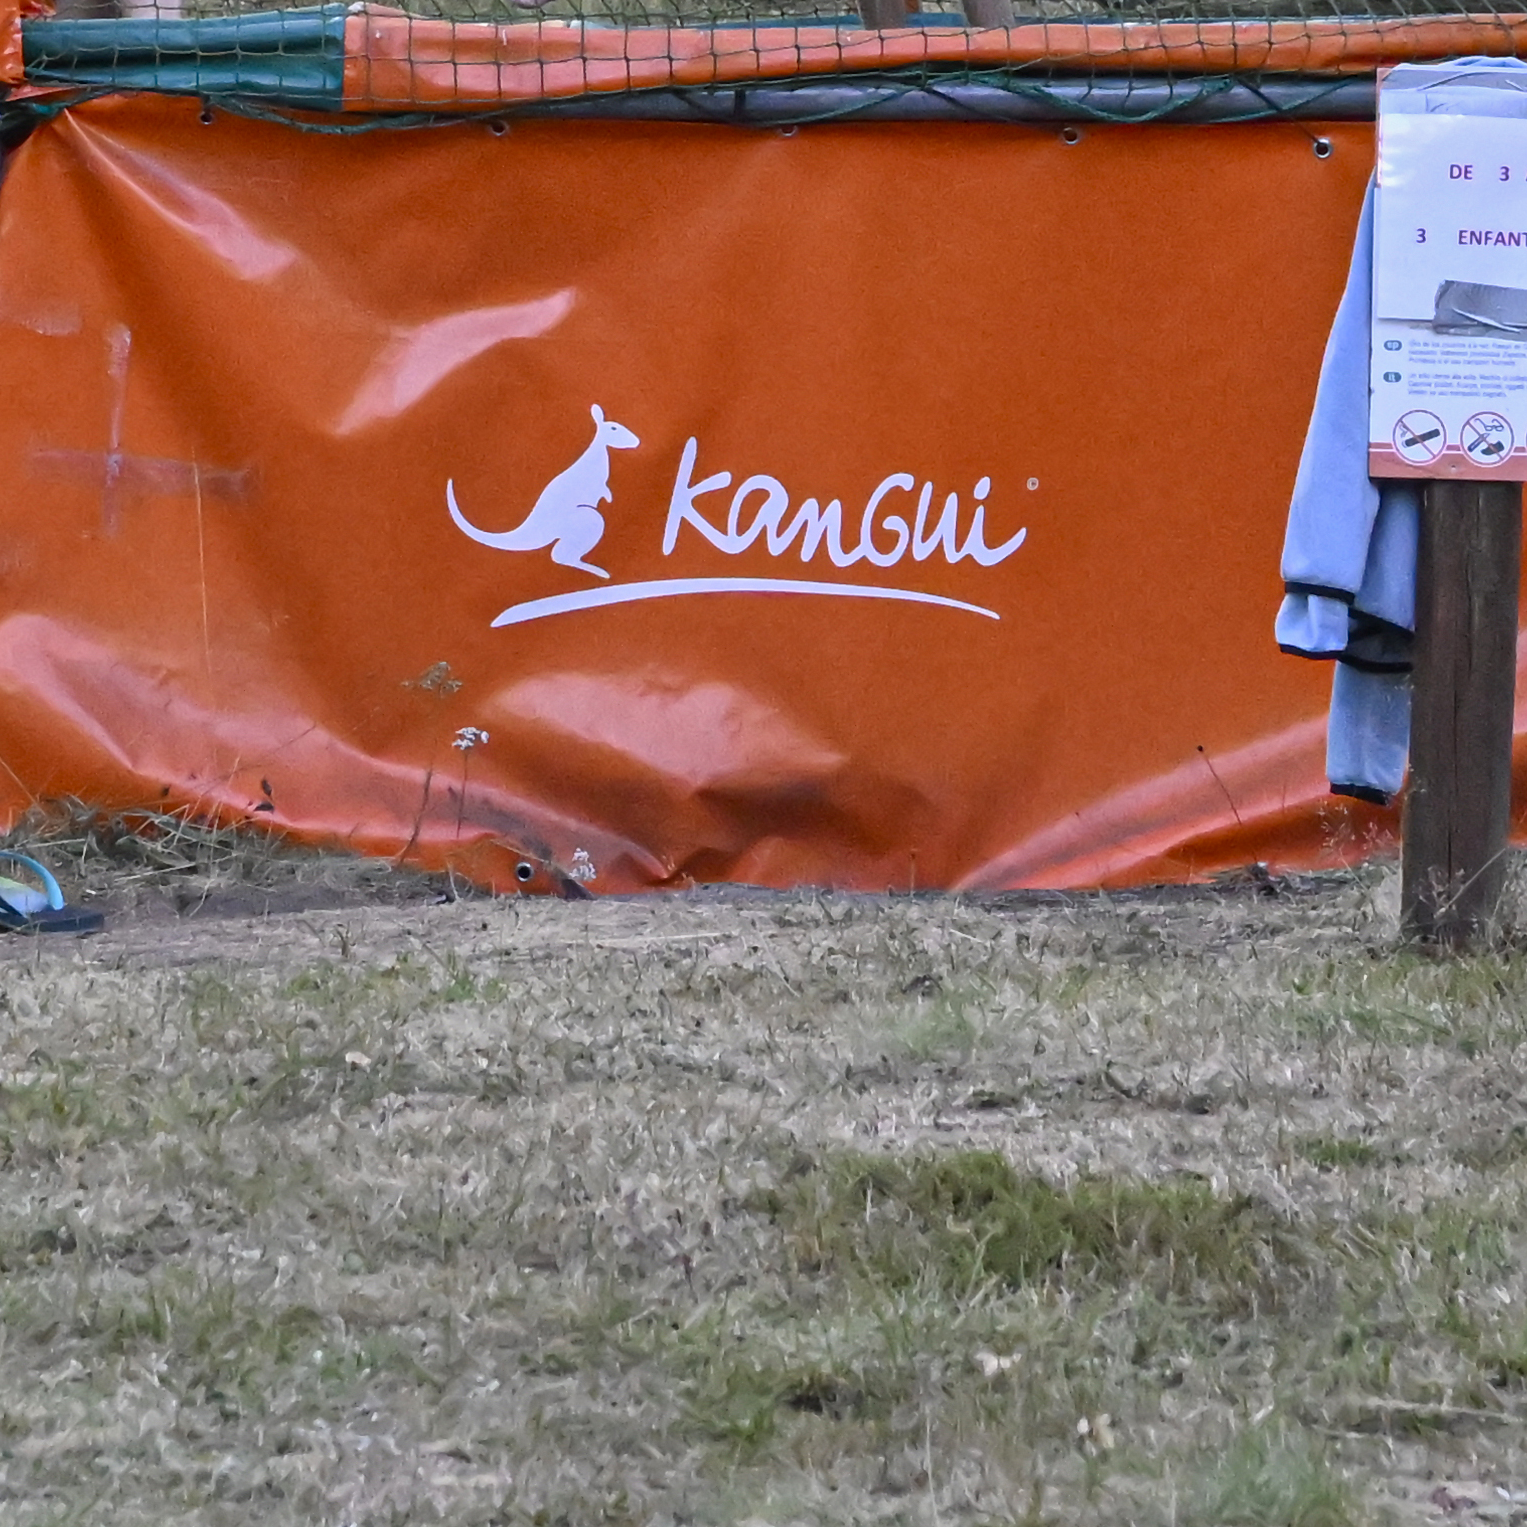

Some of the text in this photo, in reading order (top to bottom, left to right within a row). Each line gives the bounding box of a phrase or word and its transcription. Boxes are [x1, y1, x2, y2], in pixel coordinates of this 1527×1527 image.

[1449, 164, 1473, 180] DE
[1499, 166, 1510, 182] 3
[1416, 228, 1427, 244] 3
